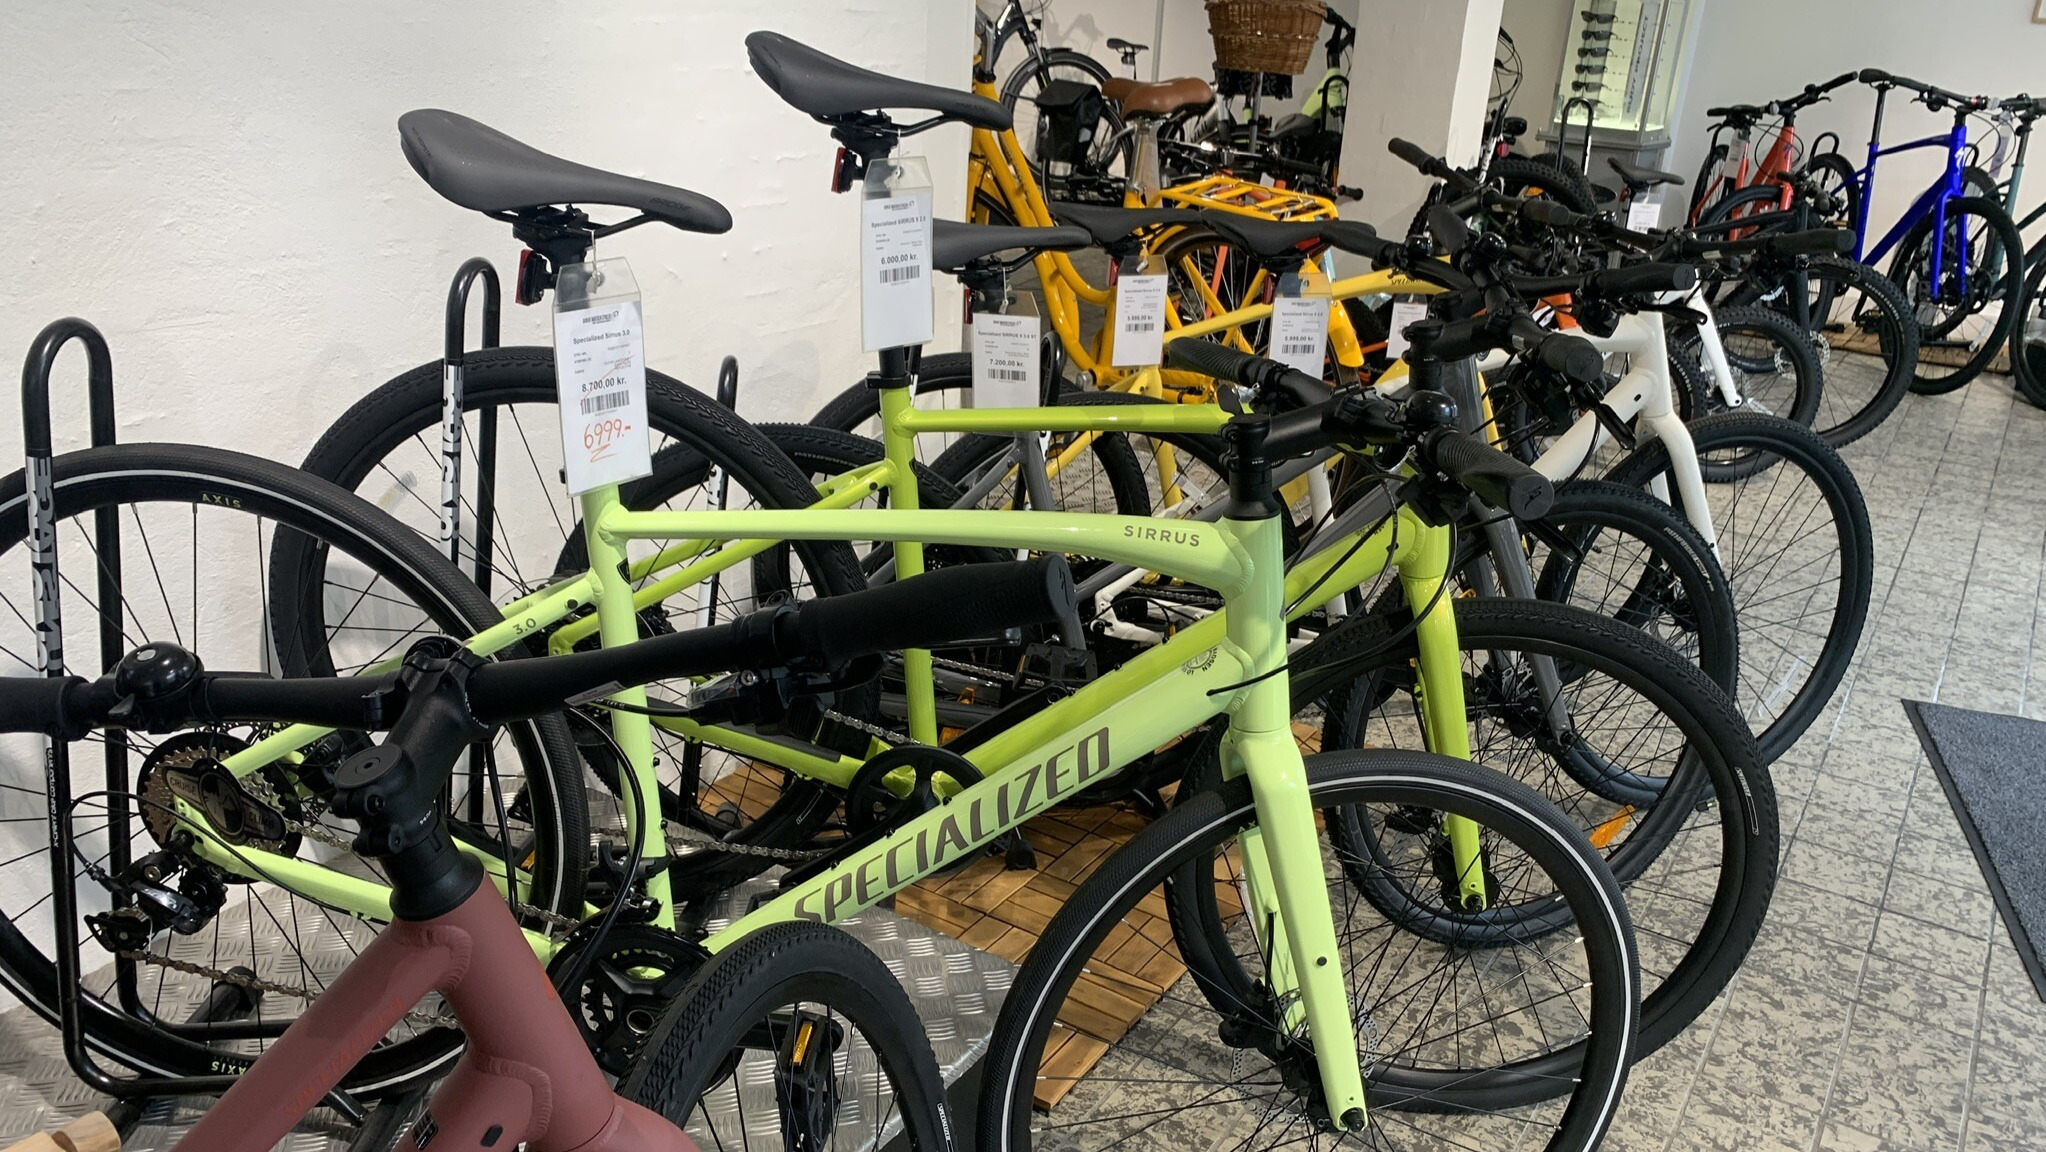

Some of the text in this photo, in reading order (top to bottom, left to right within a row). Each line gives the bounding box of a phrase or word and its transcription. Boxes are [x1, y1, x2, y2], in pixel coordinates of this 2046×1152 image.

[1634, 15, 1649, 73] PROJECT
[871, 219, 897, 229] Specialized
[880, 252, 919, 265] 6.000,00 kr.
[573, 329, 631, 345] Specialized Sirrus 3.0
[978, 330, 1002, 338] Specialized
[989, 358, 1016, 367] 7.200,00
[581, 375, 627, 393] 8.700,00 kr.
[202, 493, 242, 509] AXIS
[1124, 525, 1200, 547] SIRRUS
[512, 617, 537, 635] 3.0
[170, 776, 197, 796] CRUISE
[794, 726, 1109, 924] SPECIALIZED
[211, 1060, 248, 1076] AXIS
